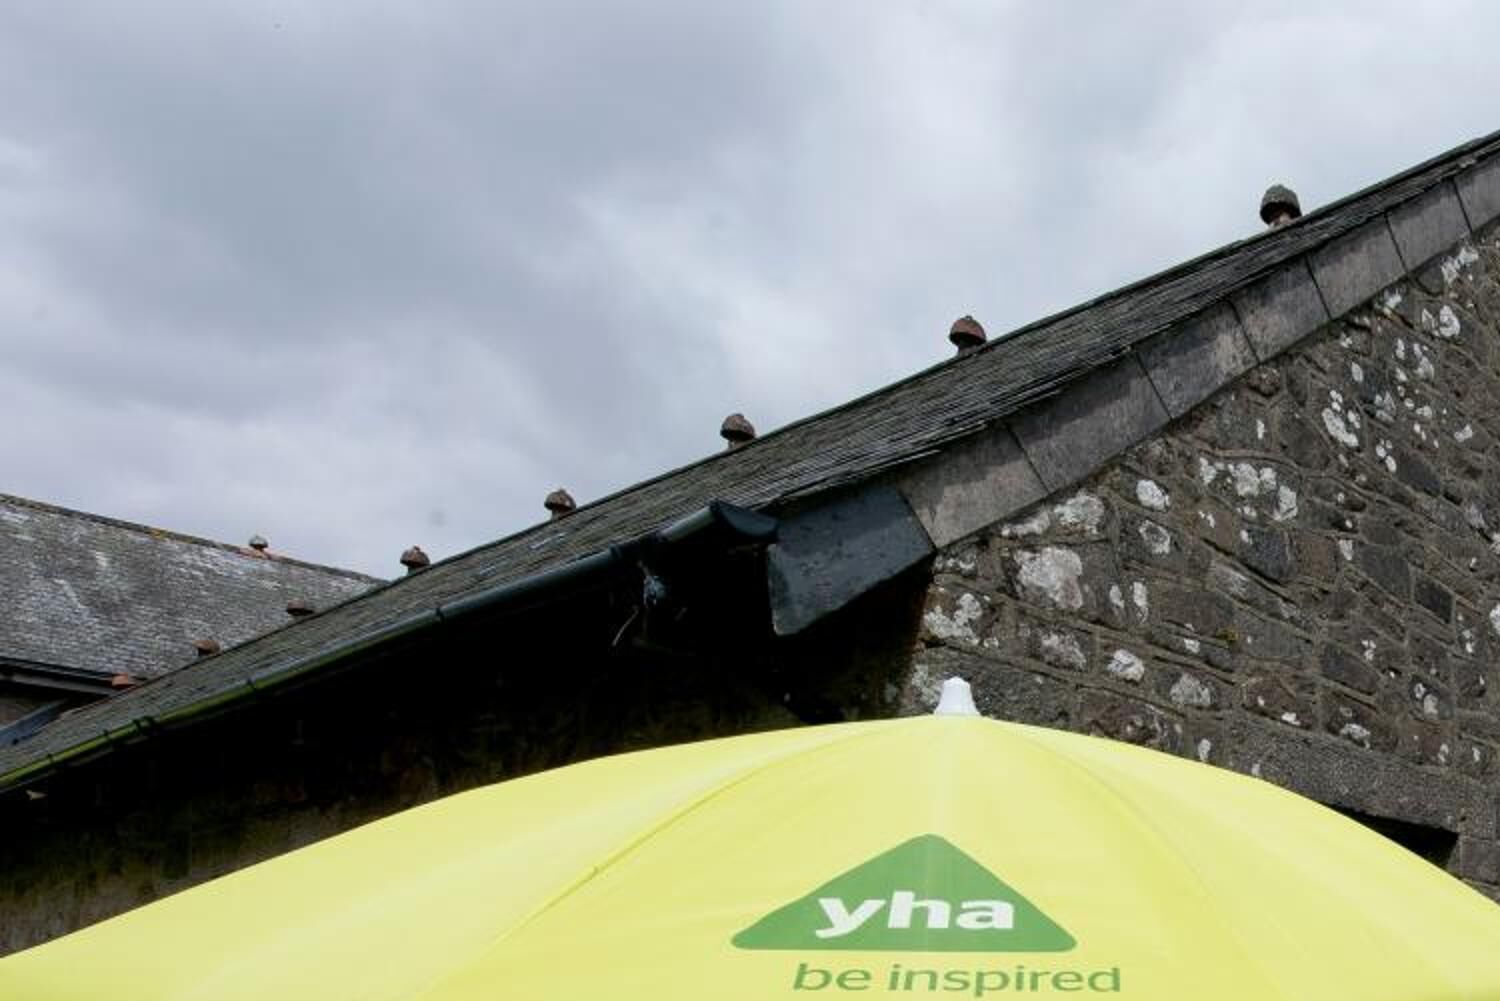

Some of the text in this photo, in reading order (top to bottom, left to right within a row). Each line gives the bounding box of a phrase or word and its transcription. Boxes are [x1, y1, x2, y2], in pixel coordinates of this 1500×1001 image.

[815, 890, 1015, 939] yha
[793, 962, 1122, 998] be inspired
